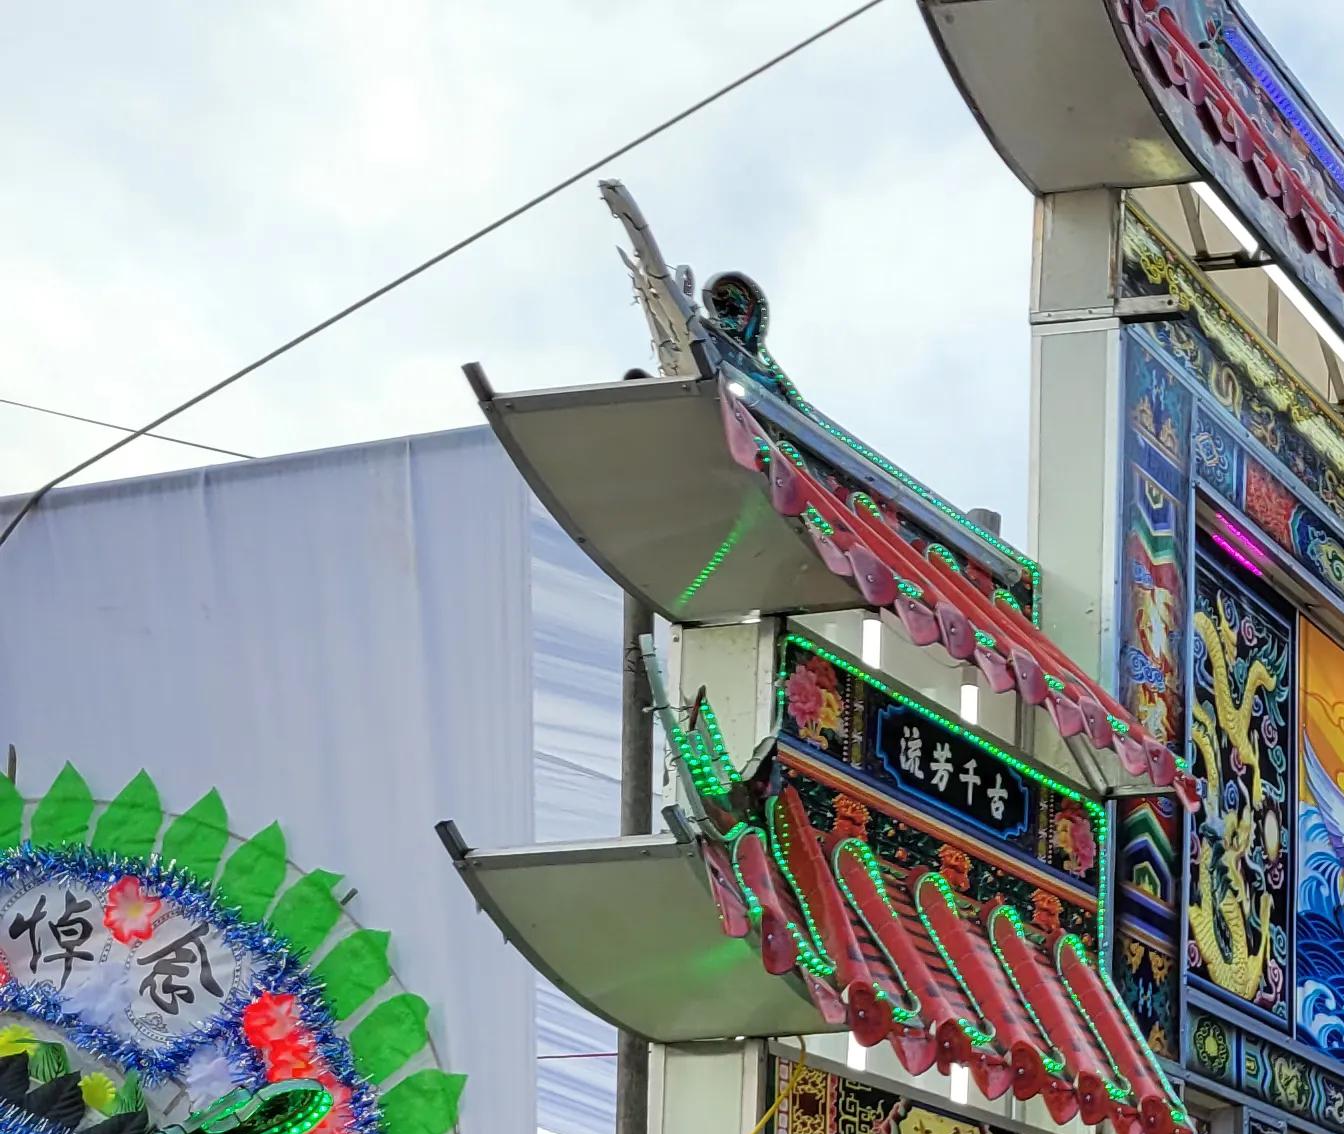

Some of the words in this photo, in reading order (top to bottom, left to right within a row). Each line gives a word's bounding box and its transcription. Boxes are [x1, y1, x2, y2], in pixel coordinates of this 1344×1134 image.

[899, 725, 1008, 821] 流芳千古
[9, 888, 225, 1016] 悼念
